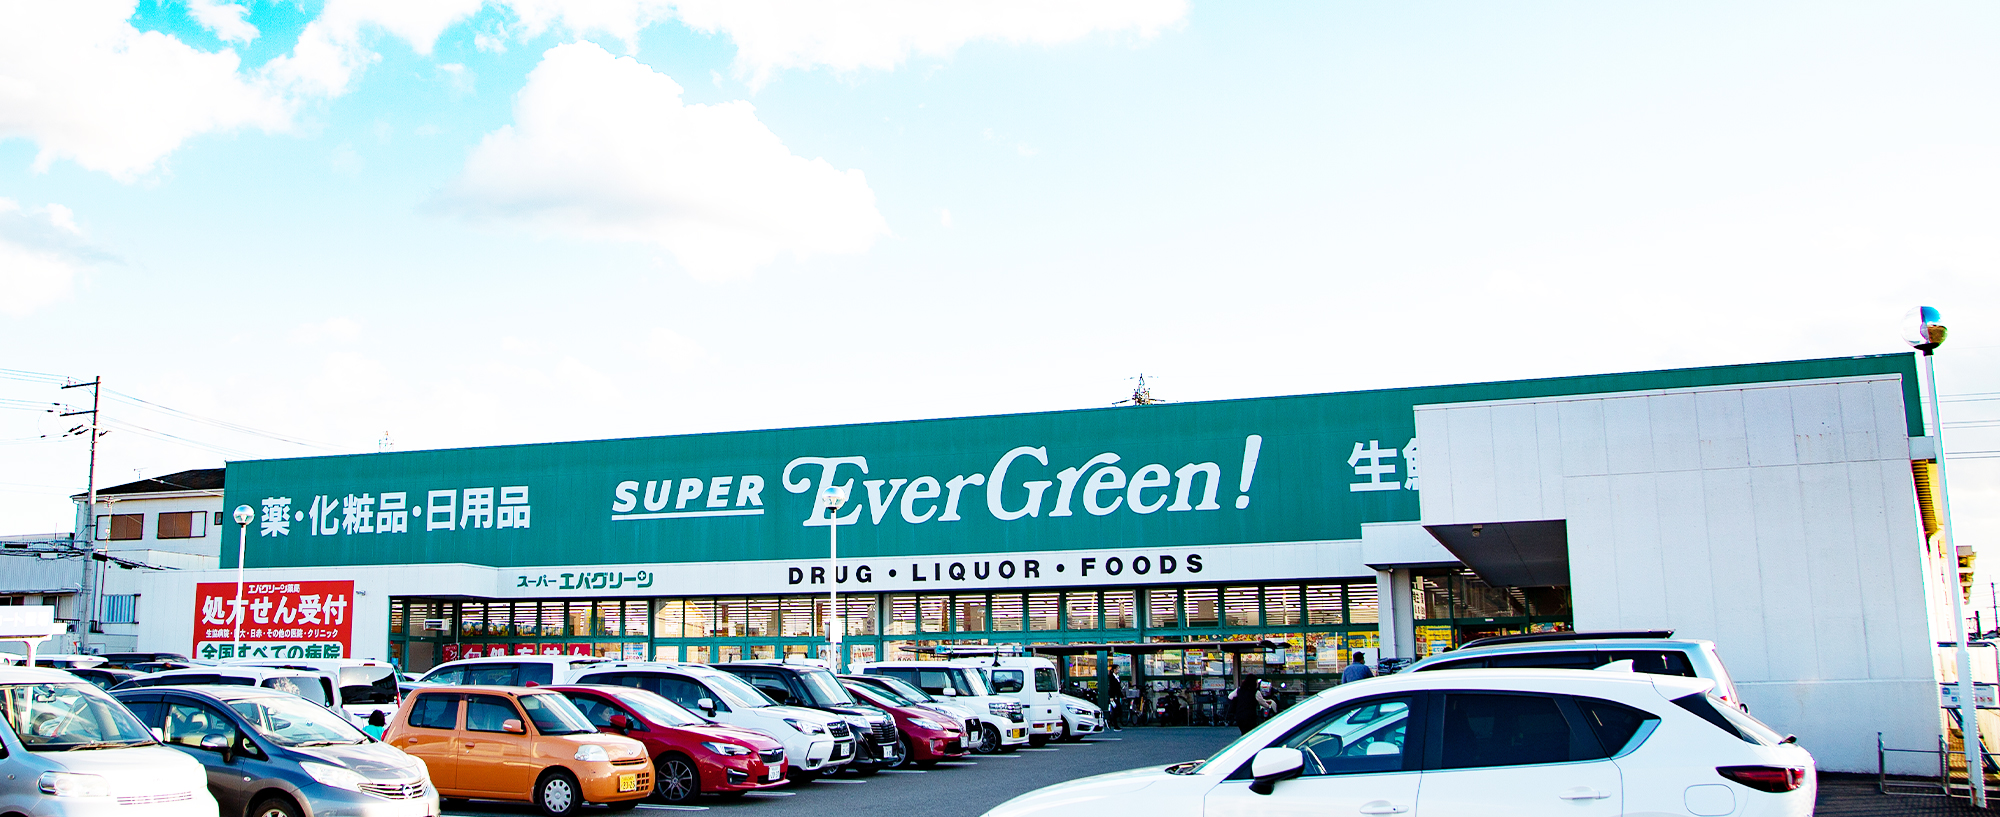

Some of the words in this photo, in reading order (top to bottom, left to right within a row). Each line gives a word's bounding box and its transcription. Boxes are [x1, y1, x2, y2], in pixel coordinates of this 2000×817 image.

[1347, 437, 1418, 492] 生
[612, 475, 765, 513] SUPER
[782, 435, 1262, 528] EverGreen!
[260, 486, 531, 537] 薬・化粧品・日用品
[516, 574, 557, 588] スーパー
[559, 570, 654, 590] エバグリーン
[788, 564, 872, 585] DRUG
[912, 560, 1040, 583] LIQUOR
[1081, 553, 1204, 579] FOODS
[202, 594, 348, 625] 処方せん受付
[201, 643, 341, 660] 全国すべての病院
